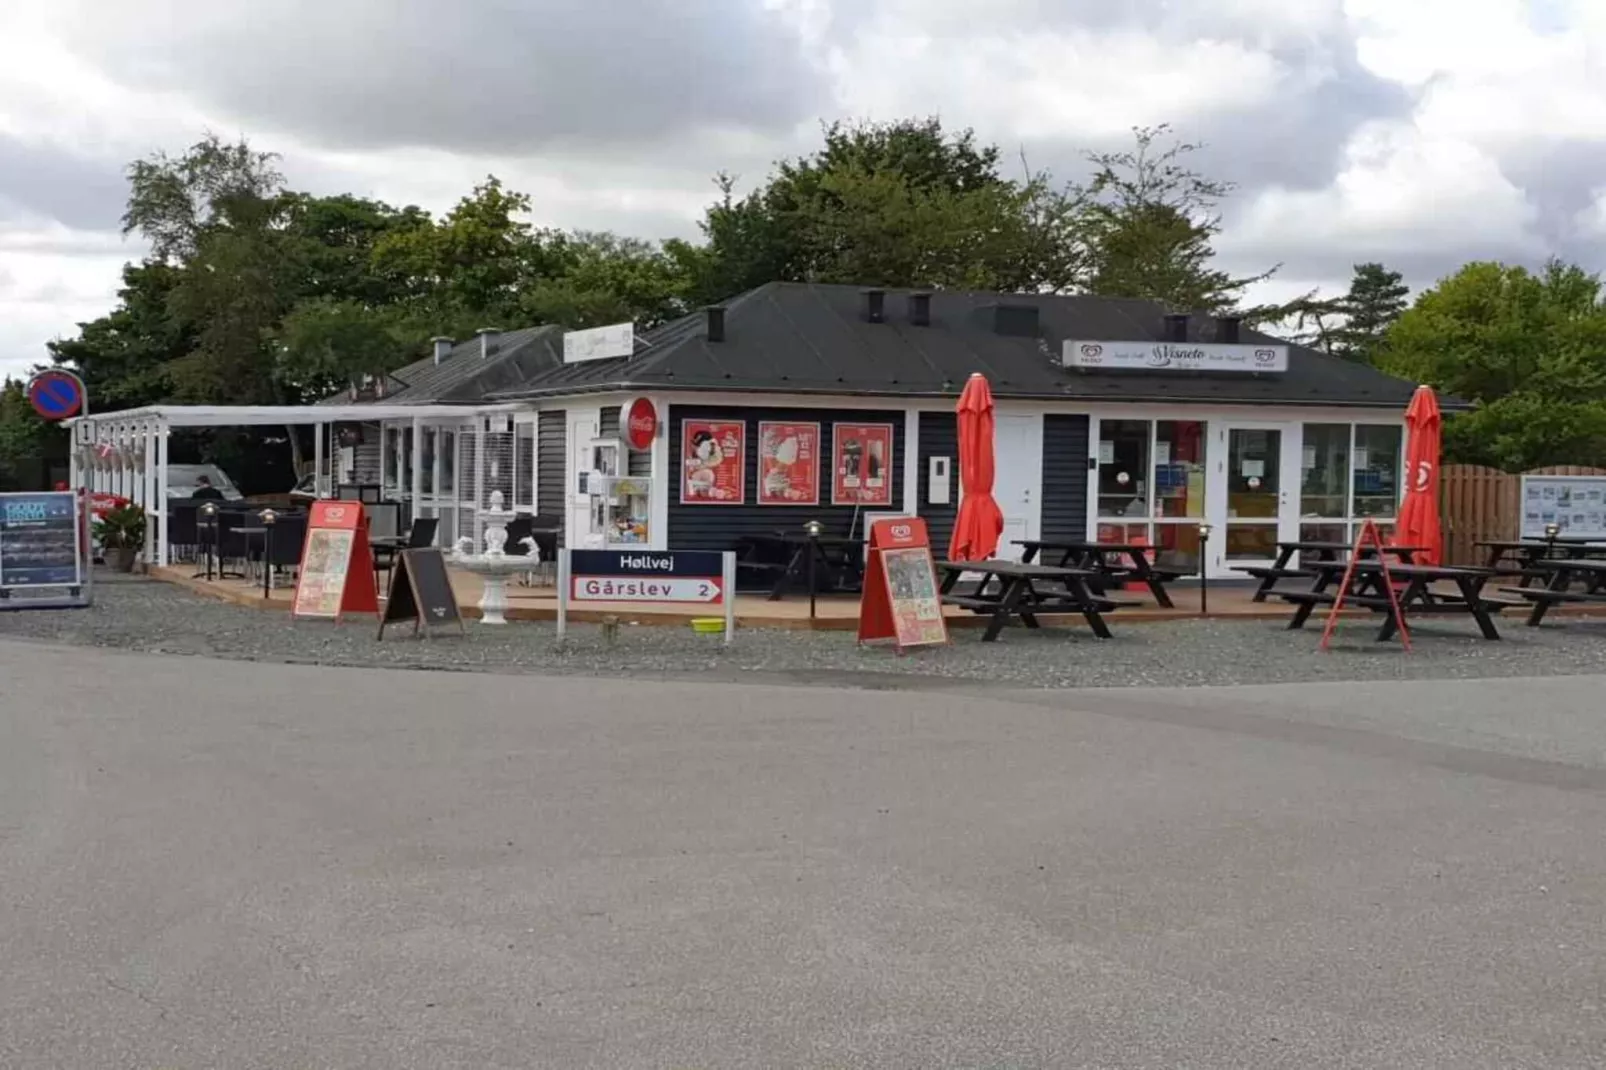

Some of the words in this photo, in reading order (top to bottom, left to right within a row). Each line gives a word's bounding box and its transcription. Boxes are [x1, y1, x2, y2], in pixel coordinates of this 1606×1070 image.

[620, 555, 674, 572] Høllvej
[586, 580, 672, 596] Gårslev
[699, 584, 709, 597] 2
